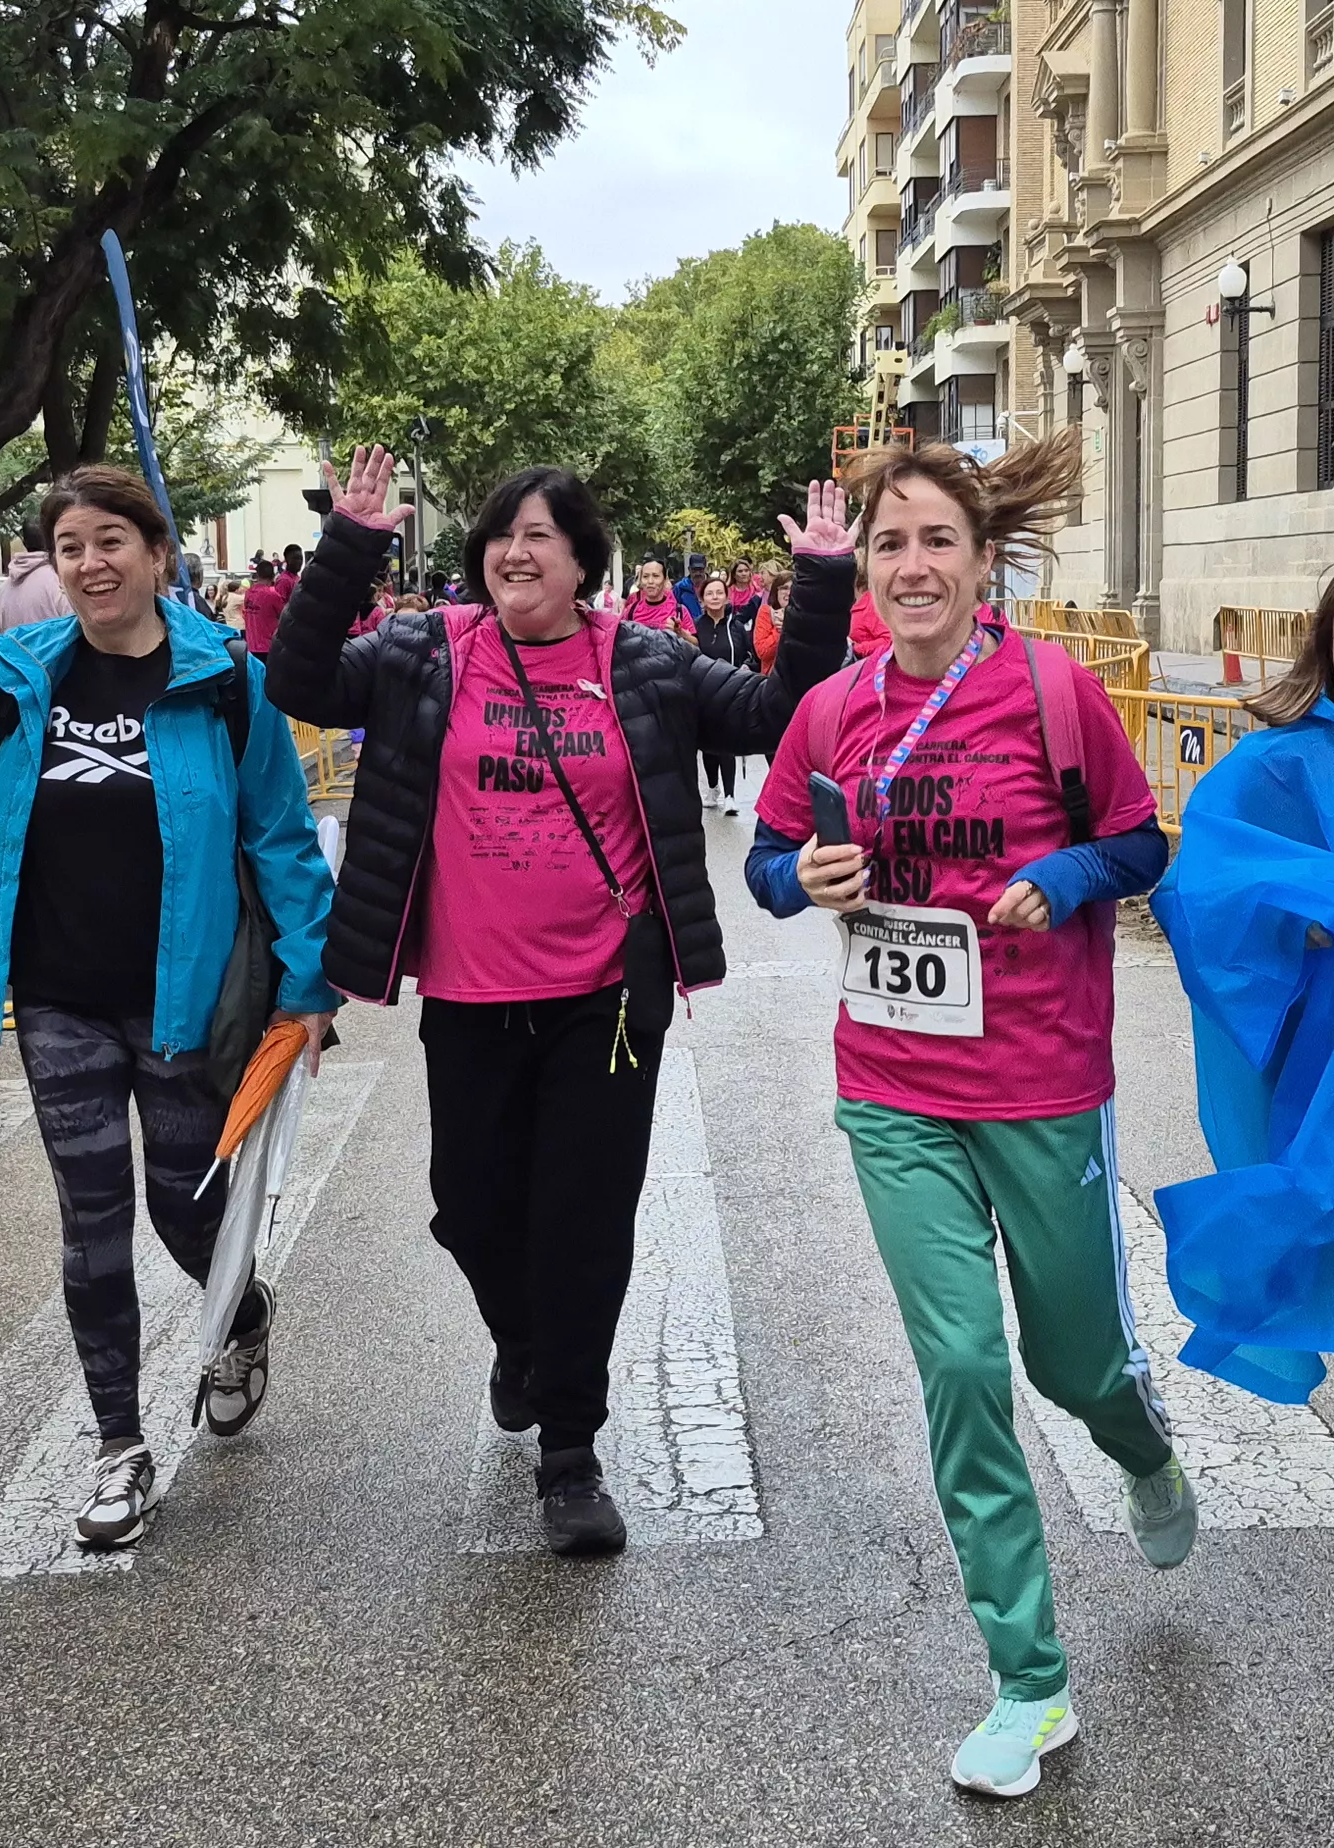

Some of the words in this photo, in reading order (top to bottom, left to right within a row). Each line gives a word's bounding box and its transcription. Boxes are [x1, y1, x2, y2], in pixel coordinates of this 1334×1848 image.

[47, 706, 146, 744] Reeb
[484, 700, 566, 728] UNIDOS
[515, 730, 545, 758] EN
[549, 730, 605, 757] CADA
[478, 755, 545, 794] PASO
[892, 820, 930, 856] EN
[933, 818, 1005, 860] CADA
[853, 921, 890, 942] CONTRA
[892, 931, 906, 945] EL
[907, 930, 962, 948] CÁNCER
[883, 918, 916, 932] HUESCA
[864, 945, 947, 998] 130
